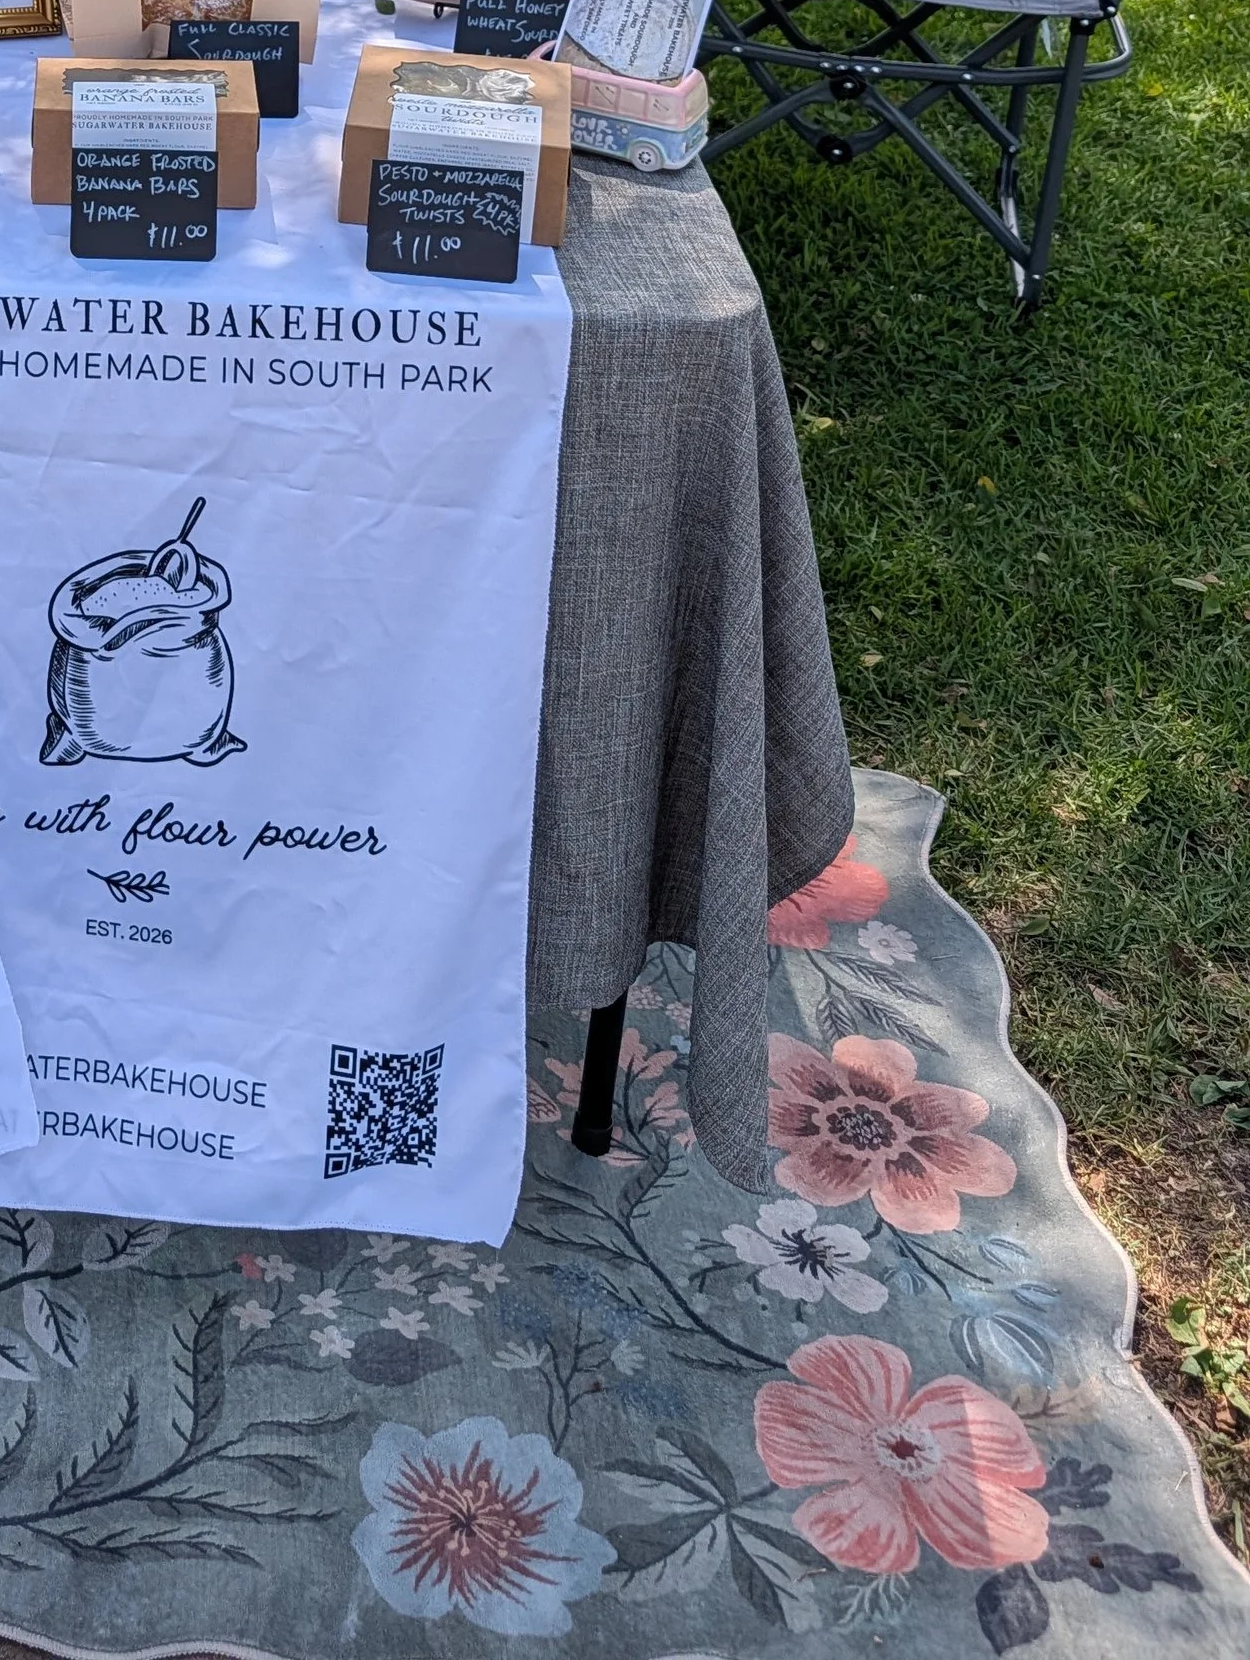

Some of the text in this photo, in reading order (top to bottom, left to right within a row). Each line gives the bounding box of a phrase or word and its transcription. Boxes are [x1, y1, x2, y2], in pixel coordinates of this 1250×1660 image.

[178, 22, 290, 37] FULL CLASSIC
[467, 15, 559, 42] WHEAT SOURD
[615, 19, 628, 46] TREATS
[630, 12, 639, 28] AND
[187, 39, 283, 60] SOURDOUGH
[628, 20, 647, 66] SOURDOUGH
[661, 30, 681, 76] BAKEHOUSE
[80, 93, 205, 103] BANANA BARS
[86, 87, 202, 97] orange frosted
[72, 121, 212, 130] SUGARWATER BAKEHOUSE
[395, 104, 538, 124] SOURDOUGH
[441, 115, 487, 126] twists
[77, 152, 216, 172] ORANGE FROSTED
[75, 174, 200, 199] BANANA BARS
[379, 164, 429, 181] PESTO
[443, 170, 523, 191] MOZZARELLA
[378, 184, 481, 206] SOURDOUGH
[399, 207, 465, 225] TWISTS
[147, 222, 208, 249] $11.00
[392, 230, 462, 265] $11.00
[187, 301, 482, 347] BAKEHOUSE
[0, 349, 207, 383] HOMEMADE
[222, 356, 254, 384] IN
[268, 358, 385, 390] SOUTH
[401, 363, 493, 392] PARK
[24, 794, 112, 834] with
[121, 802, 237, 855] flour
[242, 819, 388, 861] power
[85, 918, 173, 945] EST. 2026
